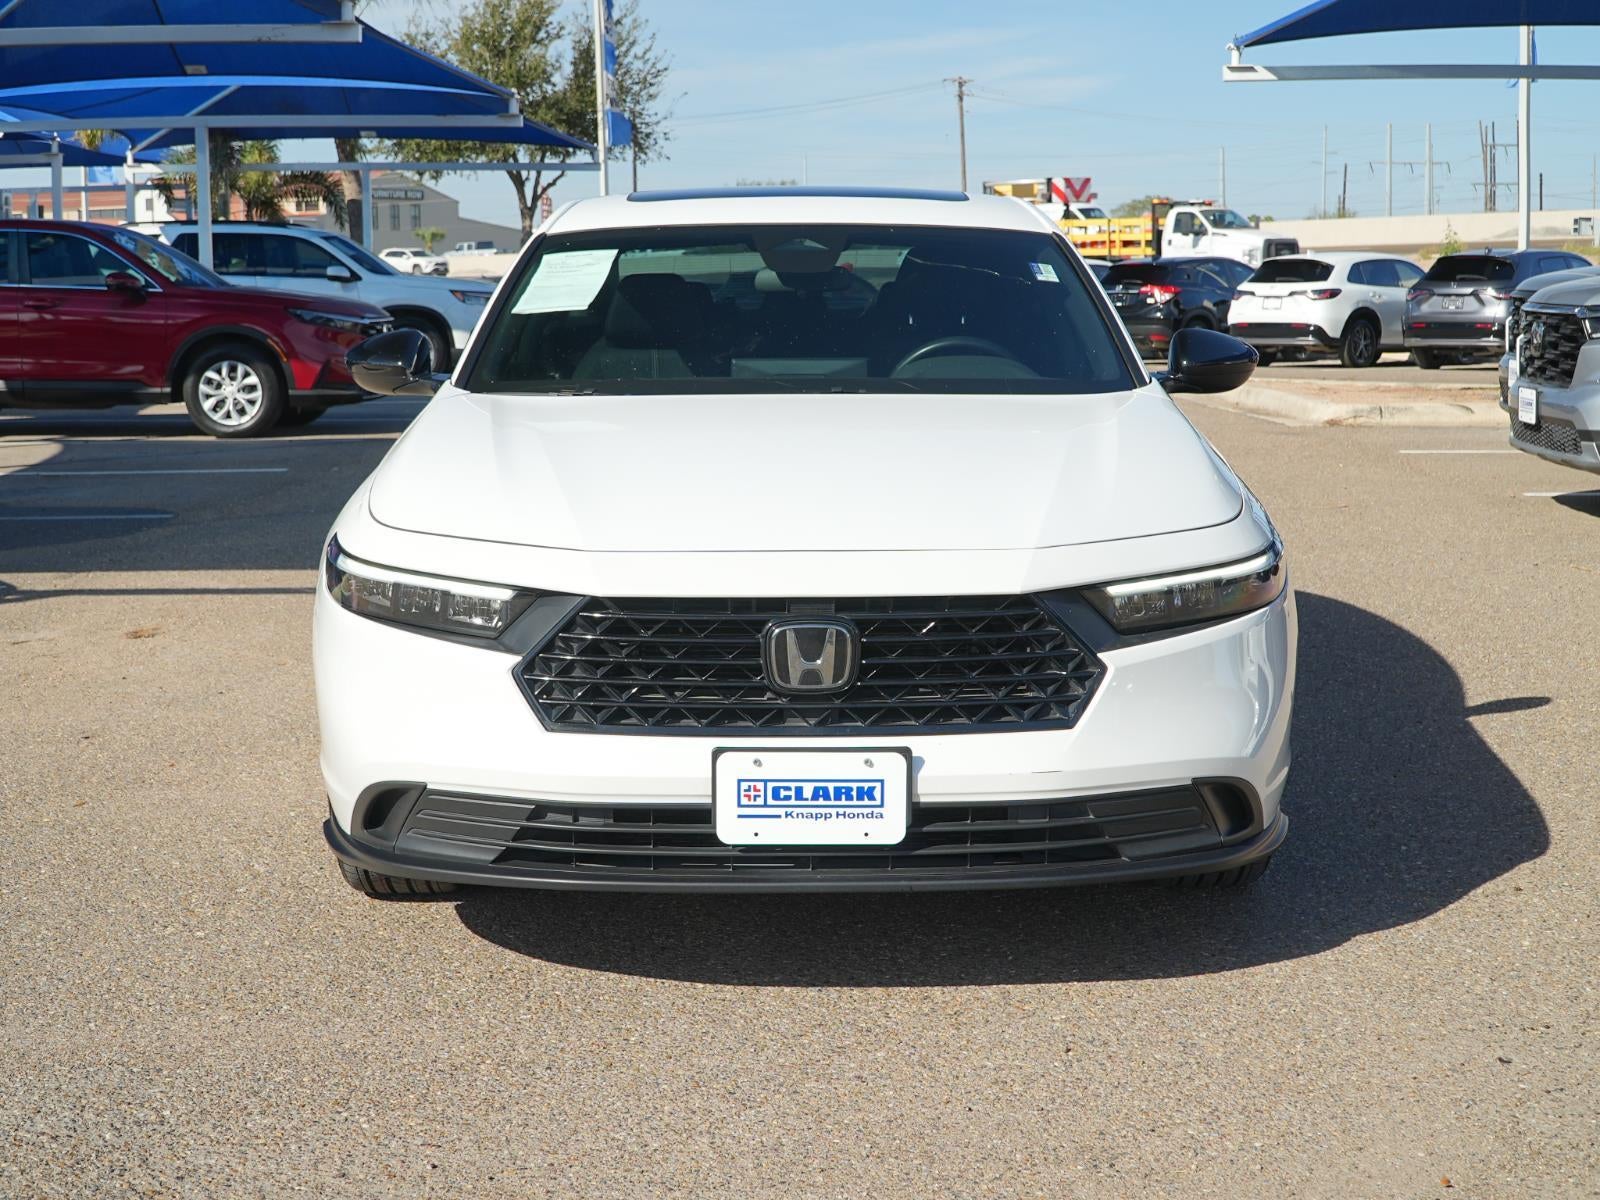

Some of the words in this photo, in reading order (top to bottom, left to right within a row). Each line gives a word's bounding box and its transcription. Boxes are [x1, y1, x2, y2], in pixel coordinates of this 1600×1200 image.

[771, 785, 877, 802] CLARK
[784, 810, 832, 822] Knapp
[836, 810, 884, 821] Honda
